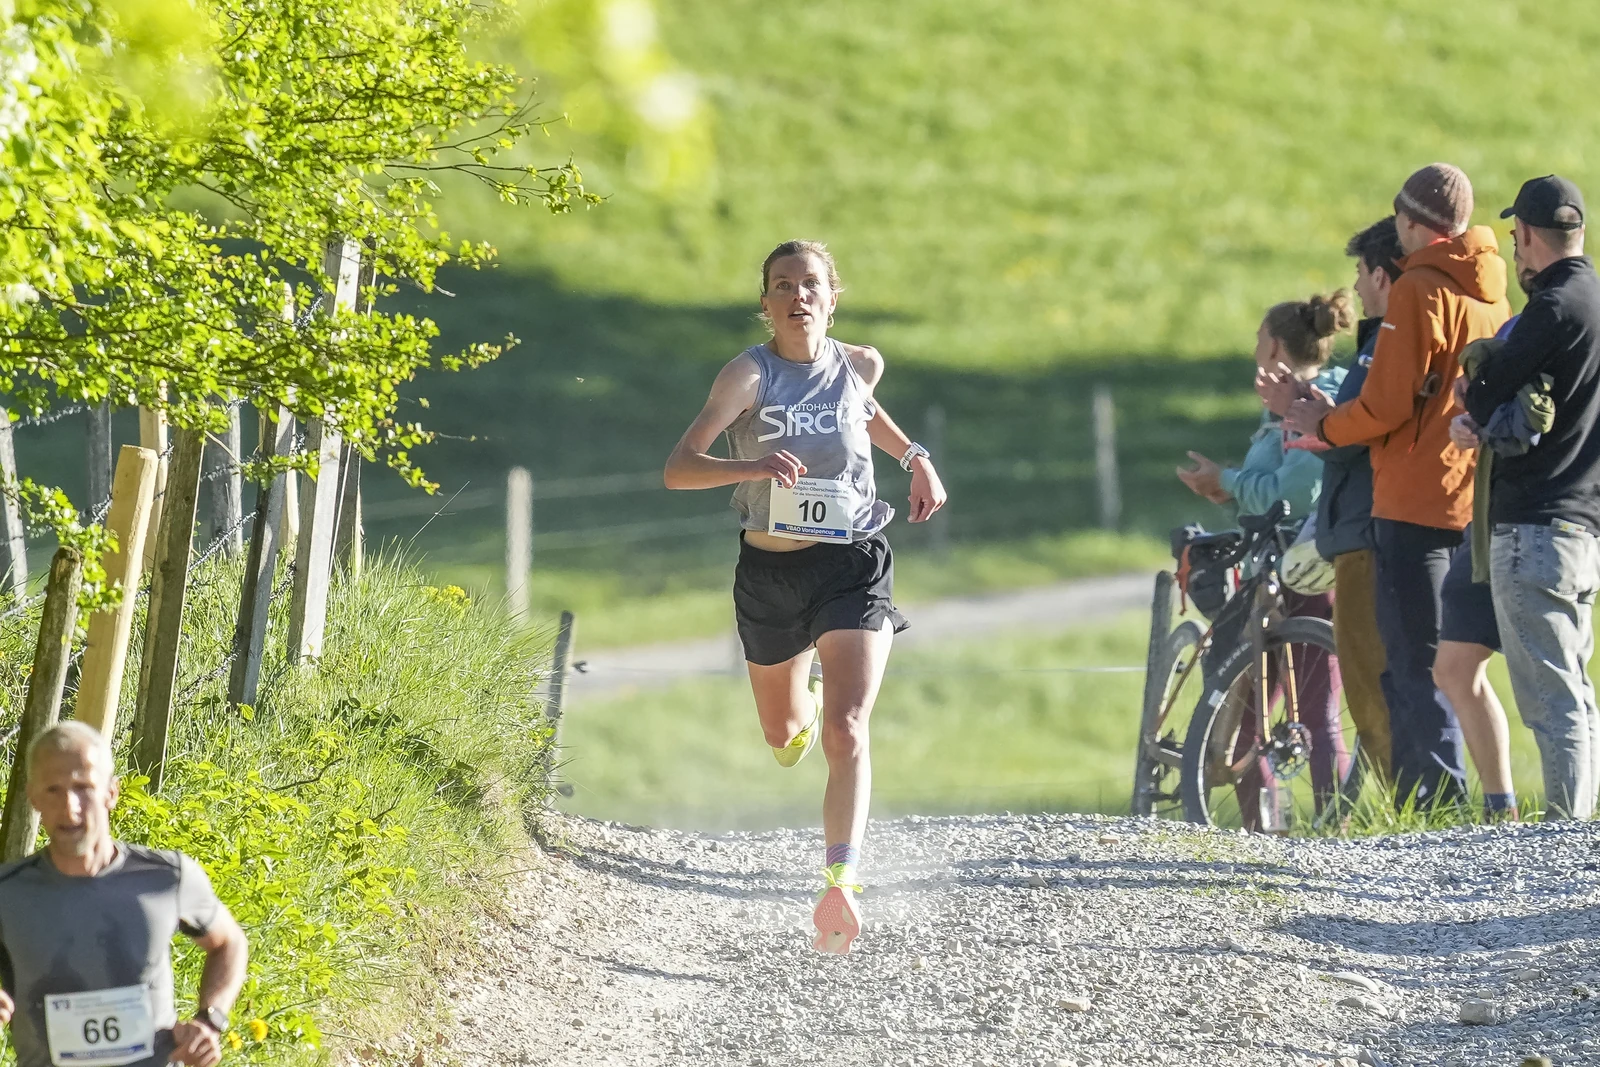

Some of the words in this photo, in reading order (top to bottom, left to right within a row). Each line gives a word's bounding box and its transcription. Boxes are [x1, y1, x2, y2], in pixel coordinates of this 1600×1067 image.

[787, 401, 842, 411] AUTOHAUS
[798, 499, 827, 523] 10
[785, 524, 801, 532] VBAO
[801, 526, 836, 536] Voralpencup
[83, 1016, 120, 1044] 66
